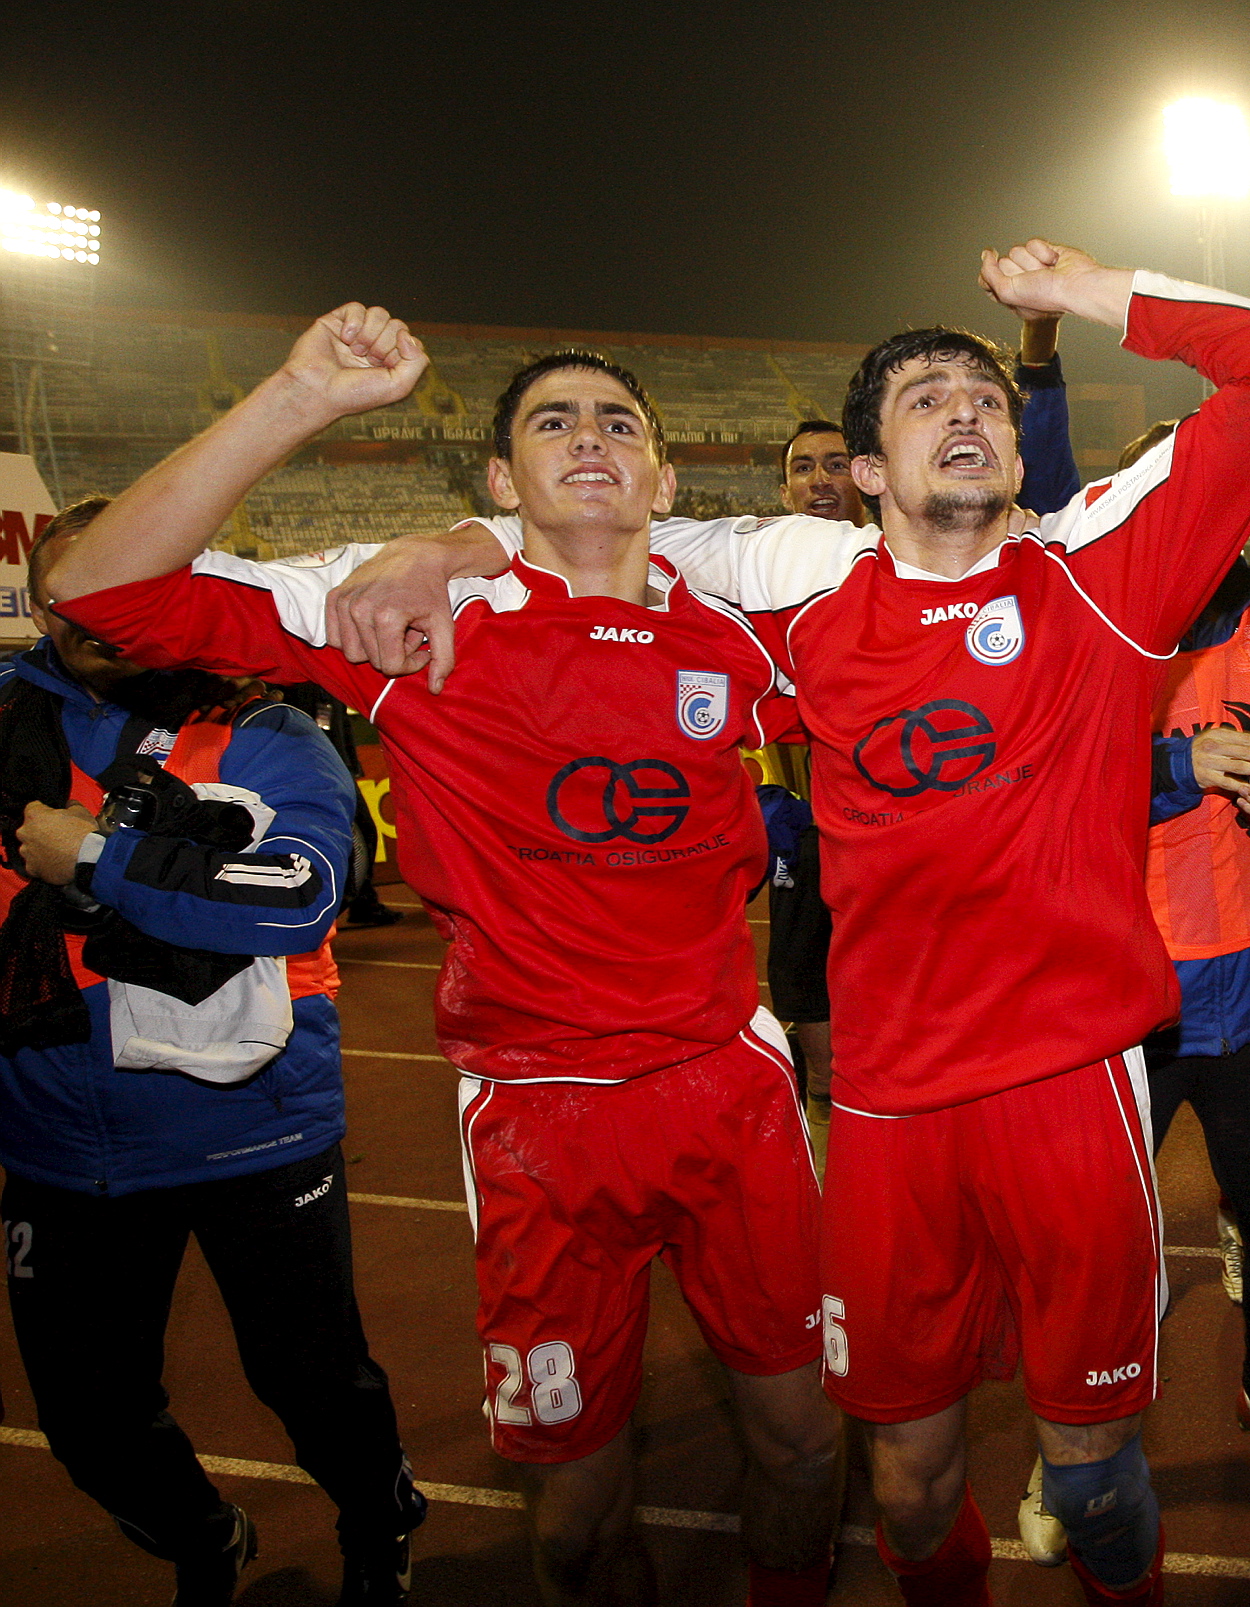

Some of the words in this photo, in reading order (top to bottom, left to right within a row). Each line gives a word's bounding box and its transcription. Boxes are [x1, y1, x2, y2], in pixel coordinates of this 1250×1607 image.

[373, 427, 423, 440] UPRAVE
[920, 602, 979, 626] JAKO
[589, 625, 655, 644] JAKO
[605, 833, 730, 867] OSIGURANJE
[278, 1132, 304, 1145] TEAM
[295, 1183, 330, 1208] JAKO
[489, 1340, 583, 1426] 28
[1085, 1362, 1141, 1387] JAKO
